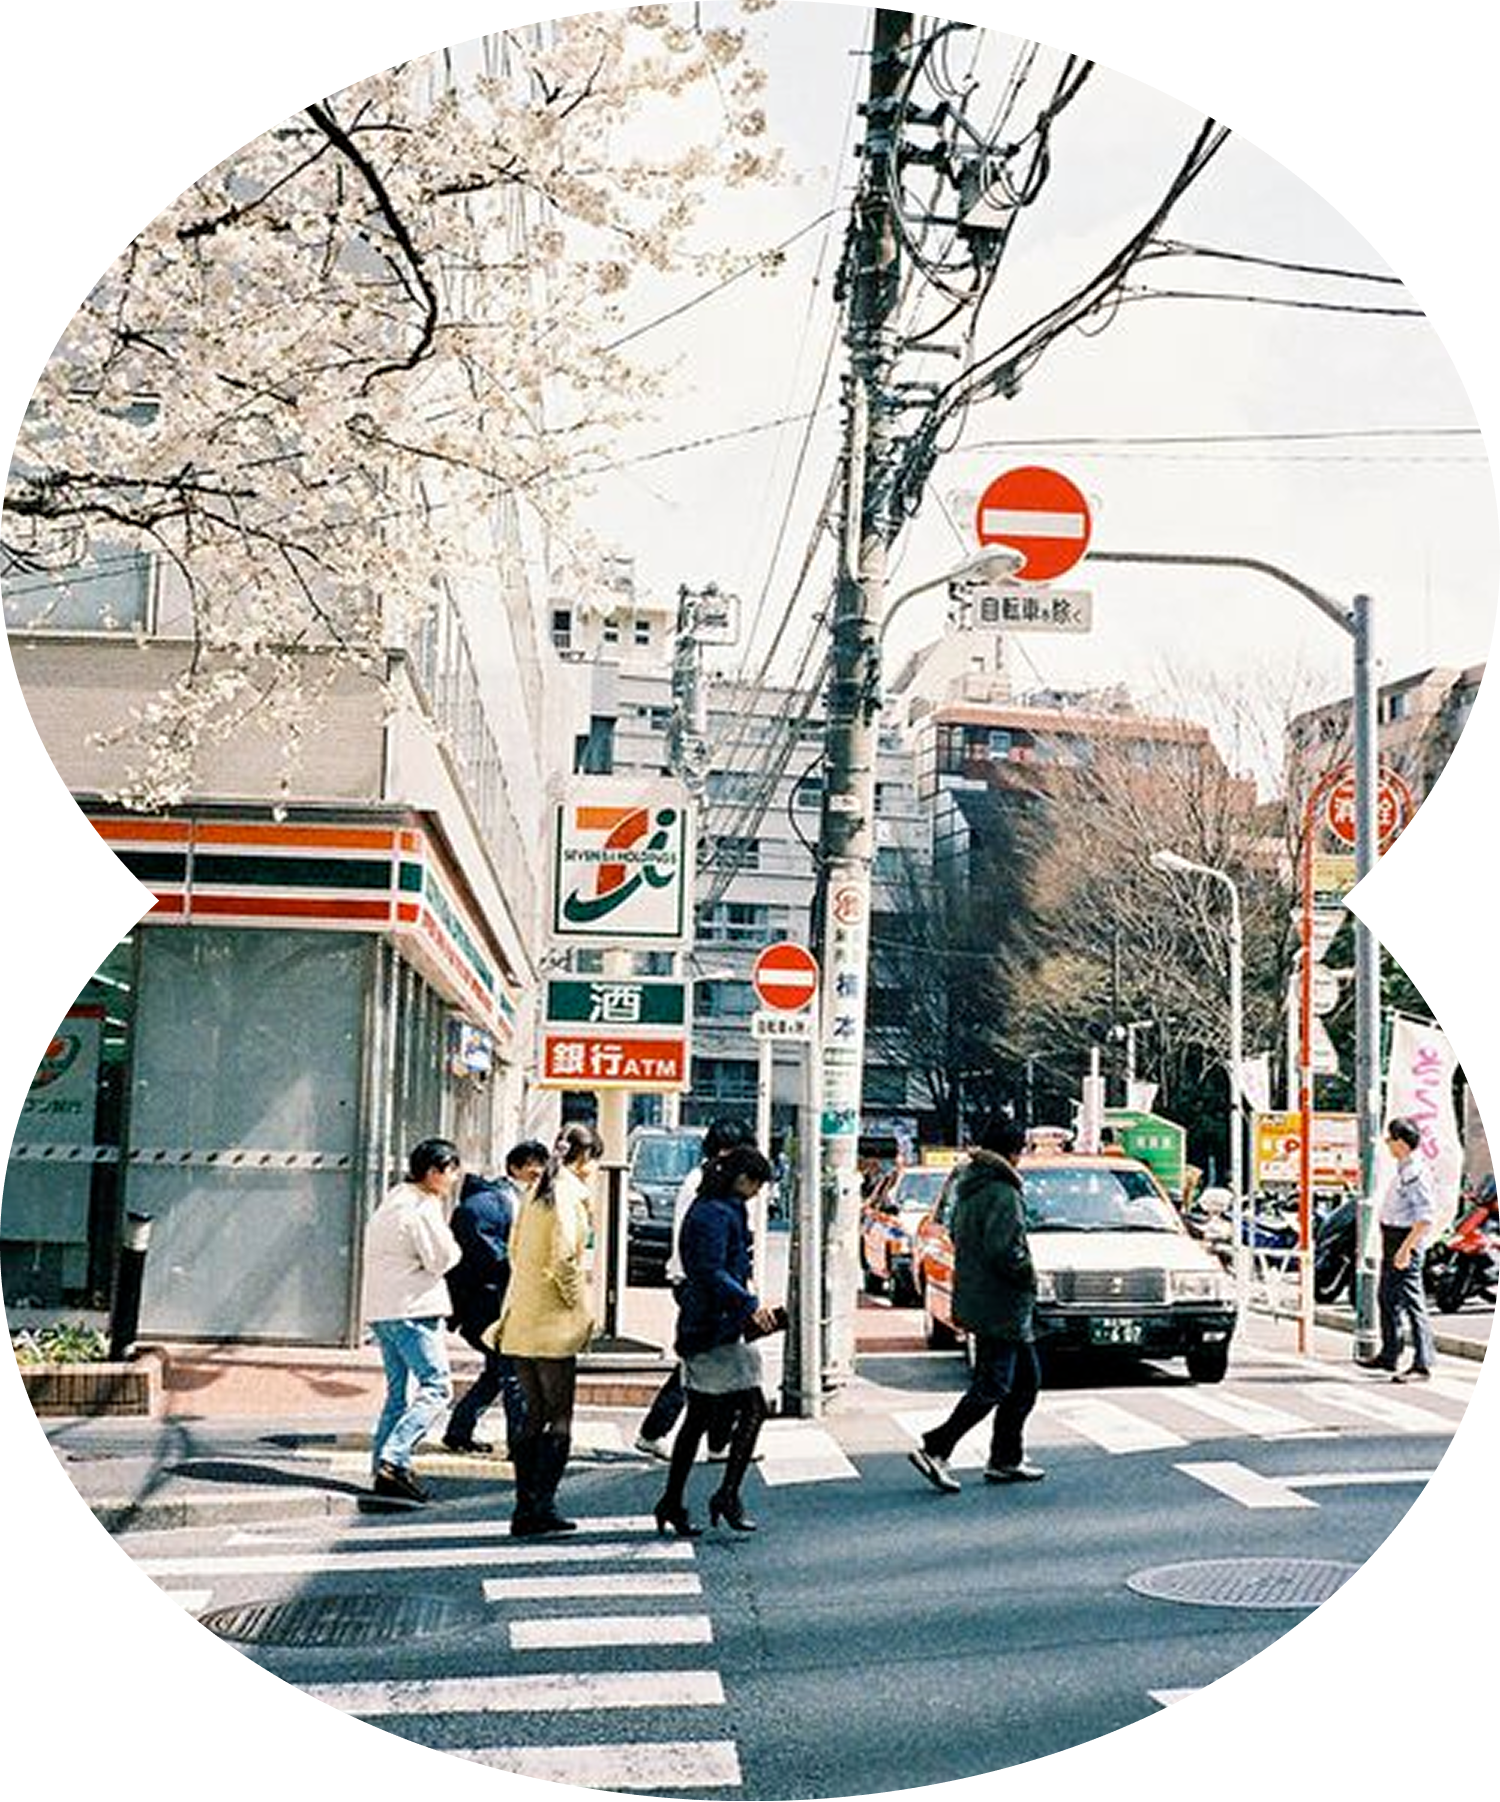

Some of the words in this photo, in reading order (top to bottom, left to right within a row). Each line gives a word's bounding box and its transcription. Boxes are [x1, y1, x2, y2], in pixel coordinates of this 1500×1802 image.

[590, 984, 641, 1022] 酒
[552, 1043, 622, 1075] 銀行
[622, 1057, 677, 1078] ATM
